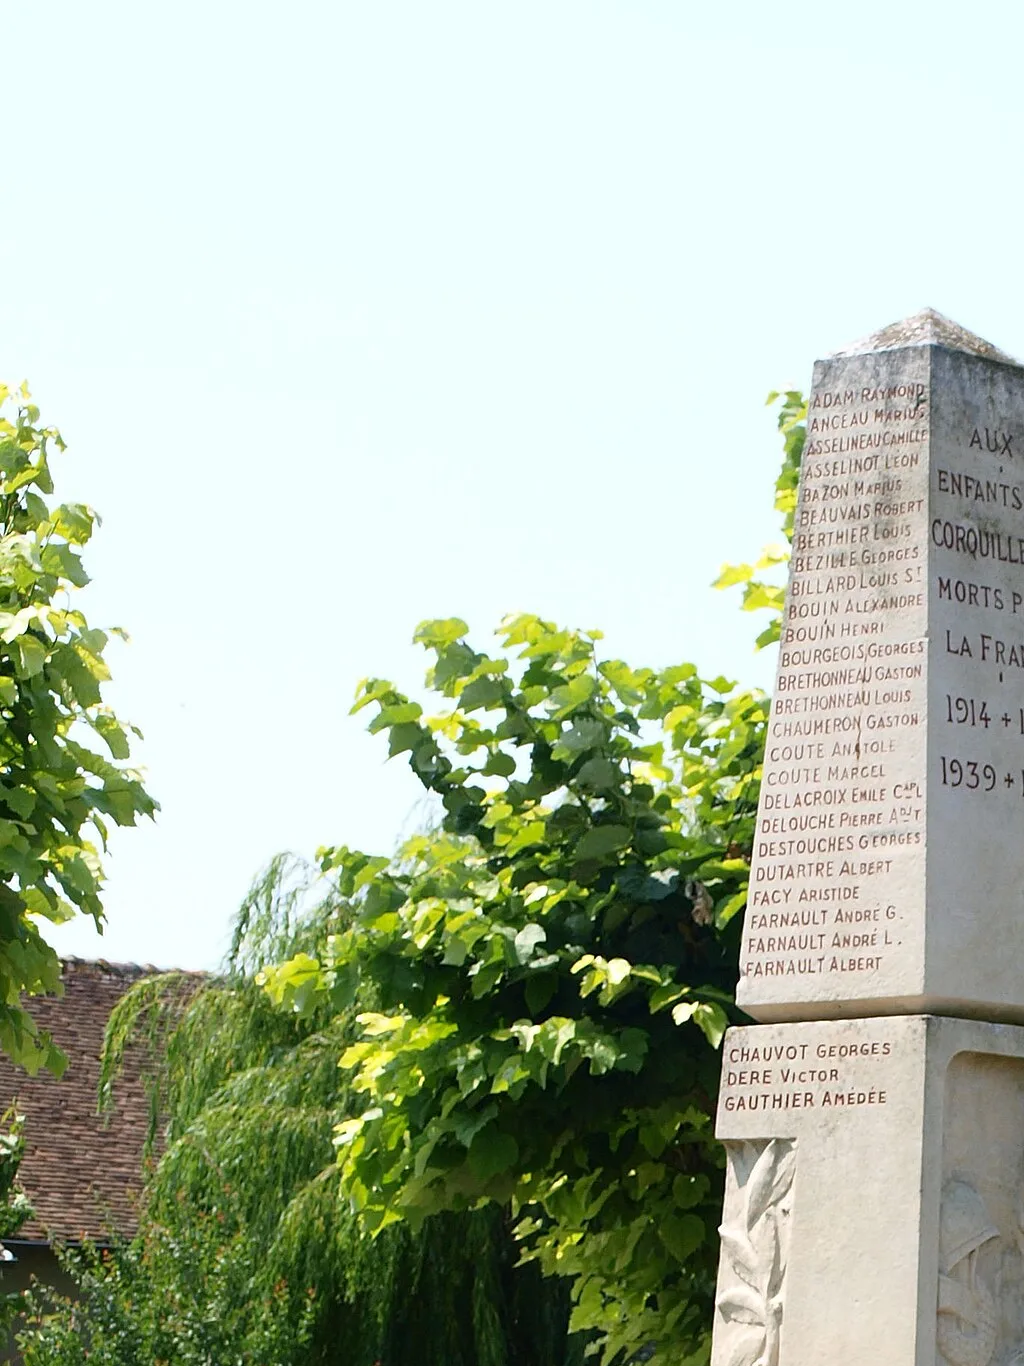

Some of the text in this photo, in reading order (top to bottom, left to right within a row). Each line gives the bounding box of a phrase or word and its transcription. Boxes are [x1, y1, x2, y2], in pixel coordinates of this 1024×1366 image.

[813, 384, 924, 409] ADAM RAYMOND
[811, 407, 925, 432] ANCEAU MARIUS
[807, 429, 928, 456] ASSELINEAU CAMILLE
[969, 428, 1013, 458] AUX
[805, 454, 878, 480] ASSELINOT
[803, 480, 901, 502] BAZON MARIUS
[938, 471, 1021, 510] ENFANTS
[800, 500, 924, 527] BEAUVAIS ROBERT
[797, 525, 911, 550] BERTHIER LOUIS
[862, 547, 918, 564] GEORGES
[792, 576, 856, 596] BILLARD
[860, 572, 898, 587] LOUIS
[938, 577, 1004, 609] MORTS
[789, 594, 923, 620] BOUIN ALEXANDRE
[785, 622, 884, 642] BOUIN HENRI
[946, 630, 973, 658] LA
[782, 641, 923, 667] BOURGEOIS GEORGES
[778, 665, 921, 691] BRETHONNEAU GASTON
[775, 690, 911, 714] BRETHONNEAU LOUIS
[946, 695, 991, 729] 1914
[773, 713, 918, 738] CHAUMERON GASTON
[770, 740, 896, 762] COUTE ANATOLE
[767, 765, 886, 786] COUTE MARCEL
[941, 757, 997, 791] 1939
[765, 789, 846, 810] DELACROIX
[851, 788, 885, 802] EMILE
[762, 812, 834, 834] DELOUCHE
[840, 812, 882, 827] PIERRE
[758, 833, 921, 857] DESTOUCHES GEORGES
[756, 860, 892, 881] DUTARTRE ALBERT
[754, 887, 859, 905] FACY ARISTIDE
[750, 909, 829, 929] FARNAULT
[834, 903, 880, 922] ANDRÉ
[748, 934, 826, 953] FARNAULT
[832, 928, 877, 947] ANDRÉ
[746, 956, 882, 977] FARNAULT ALBERT
[729, 1043, 891, 1063] CHAUVOT GEORGES
[728, 1069, 839, 1085] DERE VICTOR
[725, 1085, 886, 1111] GAUTHIER AMÉDÉE
